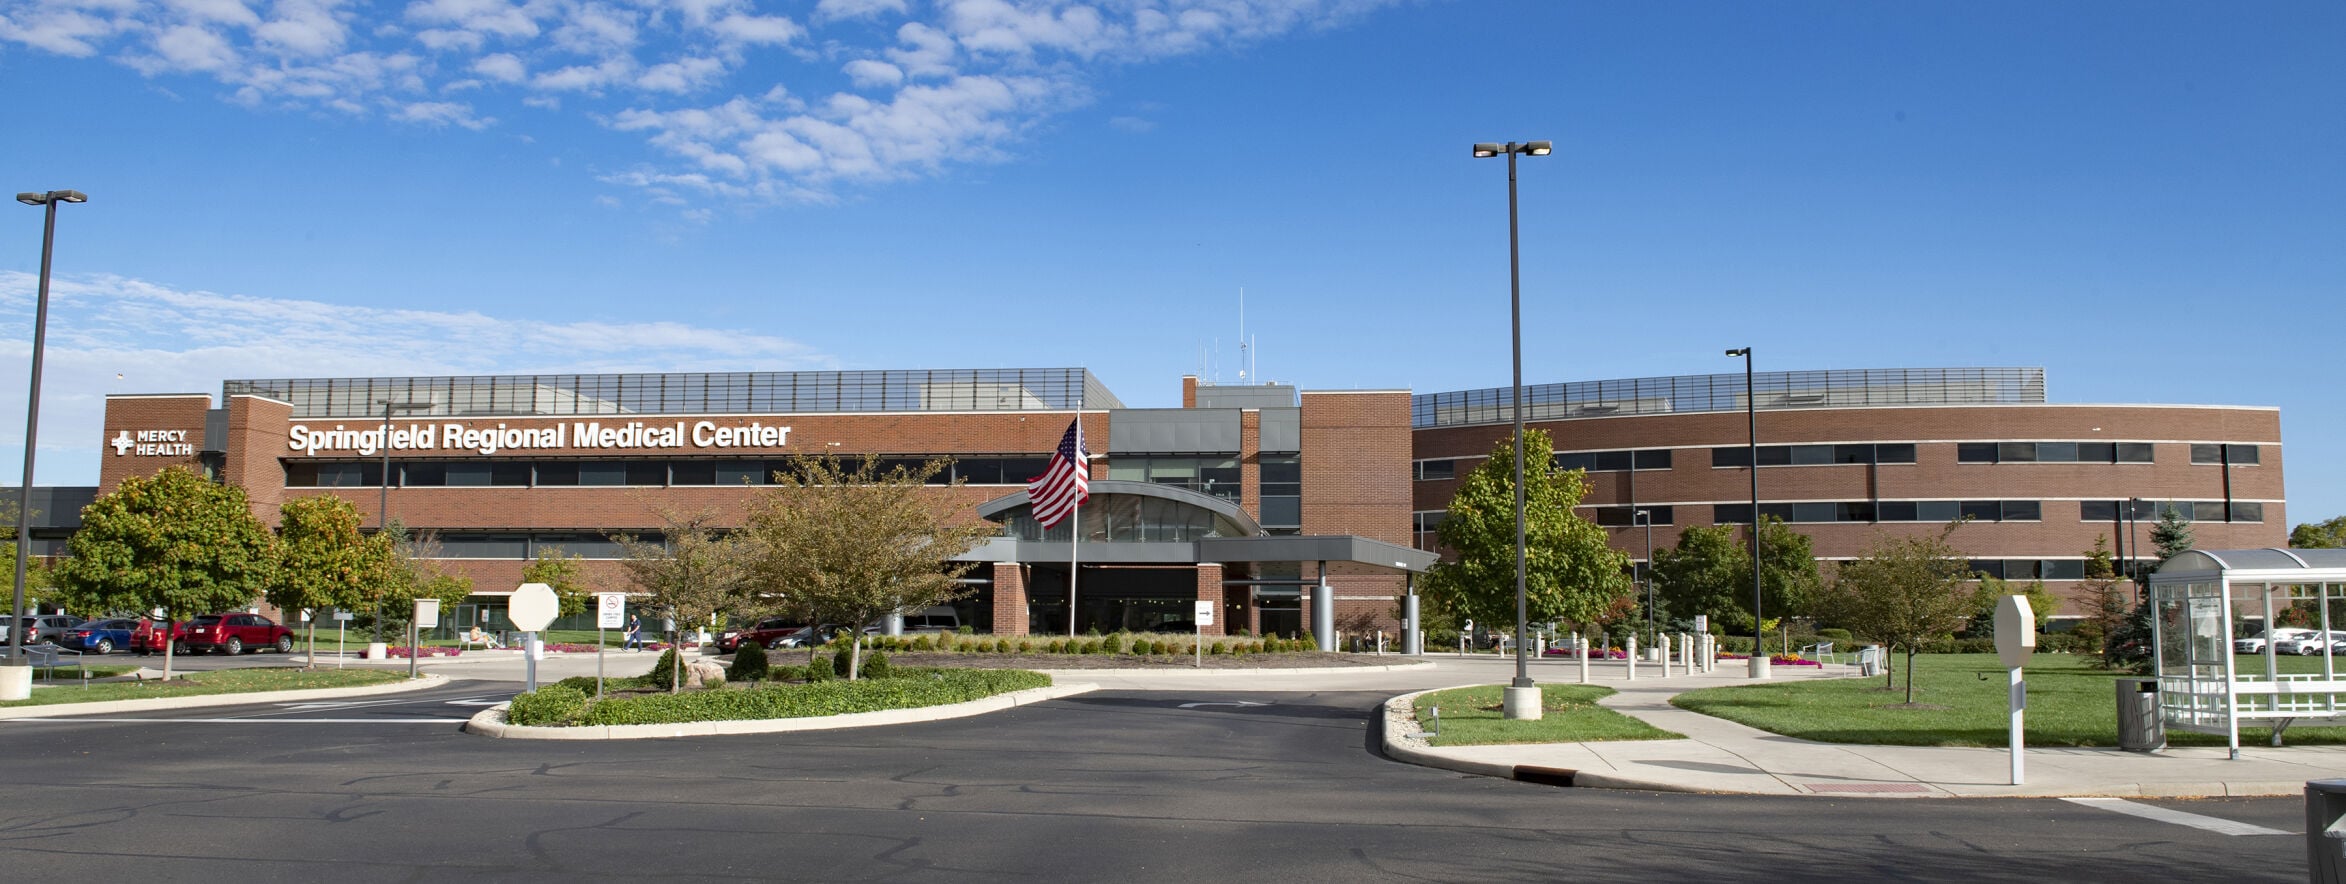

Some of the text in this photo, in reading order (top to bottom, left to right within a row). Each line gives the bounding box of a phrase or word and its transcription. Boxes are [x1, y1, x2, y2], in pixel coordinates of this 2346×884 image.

[137, 430, 187, 442] MERCY
[289, 420, 791, 456] Springfield Regional Medical Center
[136, 443, 192, 456] HEALTH
